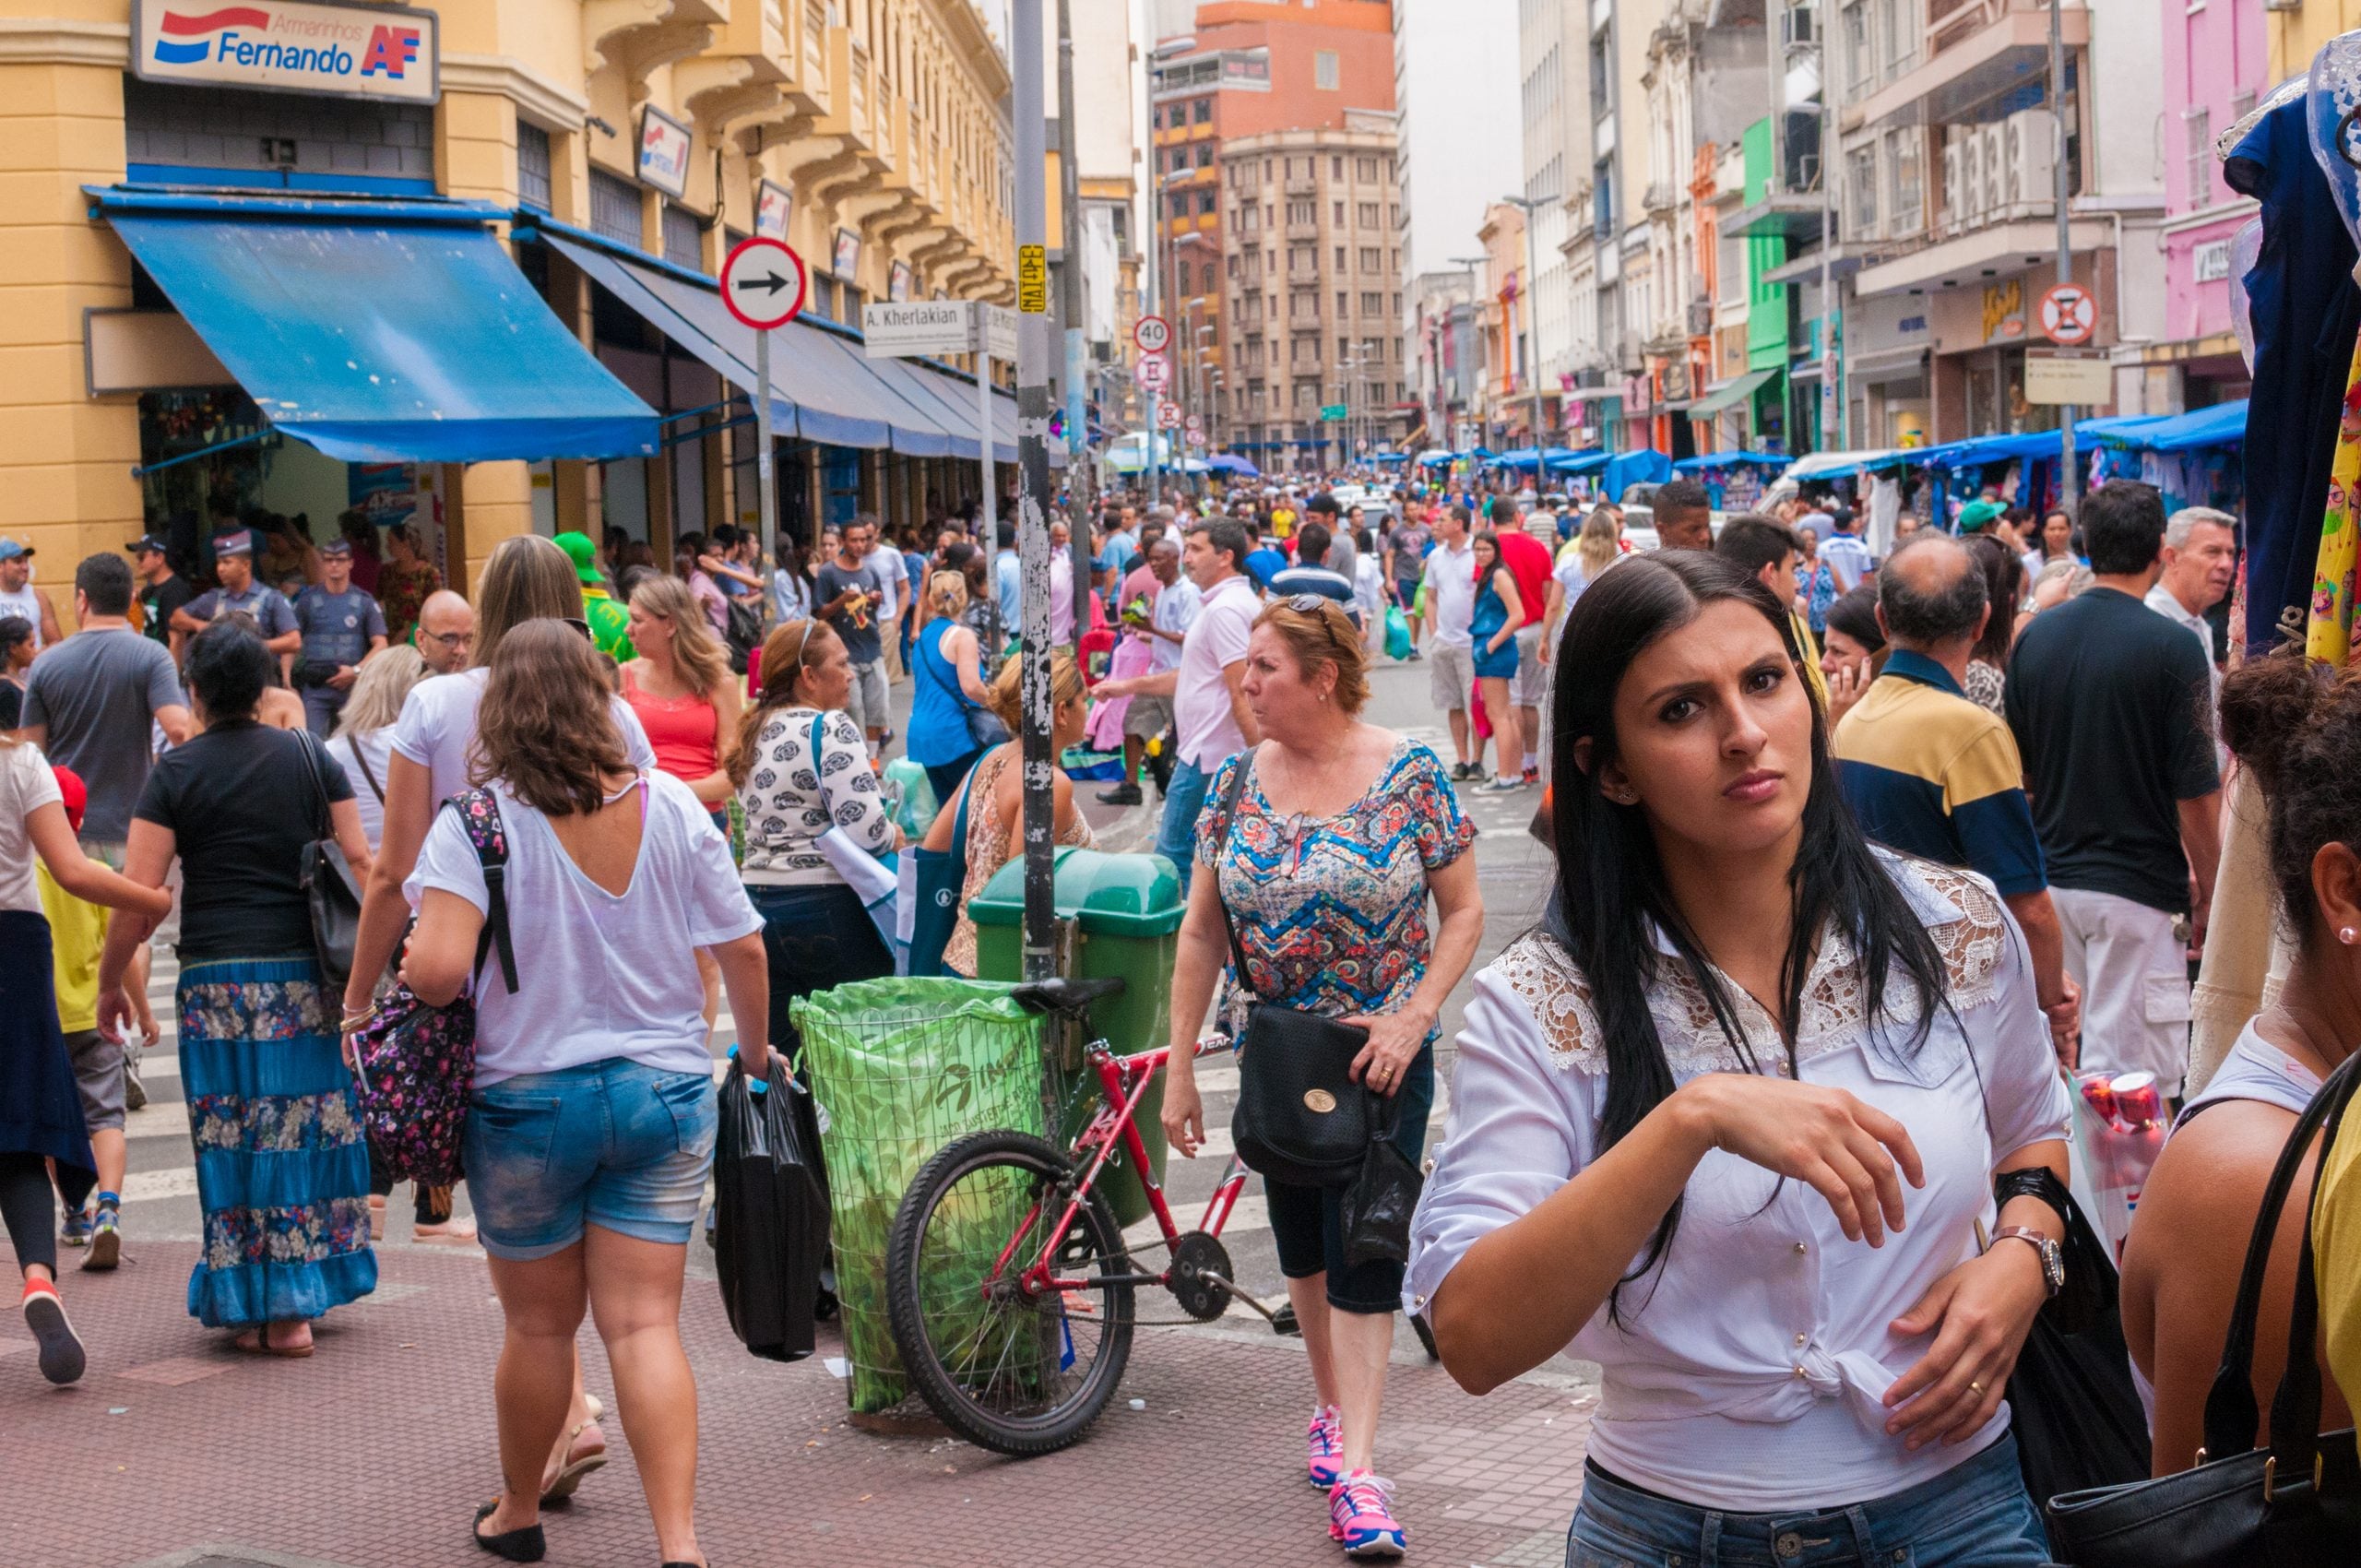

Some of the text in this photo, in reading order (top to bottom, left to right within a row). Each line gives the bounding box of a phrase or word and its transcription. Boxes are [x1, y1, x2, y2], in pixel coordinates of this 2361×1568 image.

[273, 14, 362, 40] Armarinhos
[218, 31, 352, 75] Fernando
[361, 24, 421, 79] AF
[867, 307, 957, 327] A. Kherlakian
[1141, 325, 1164, 340] 40
